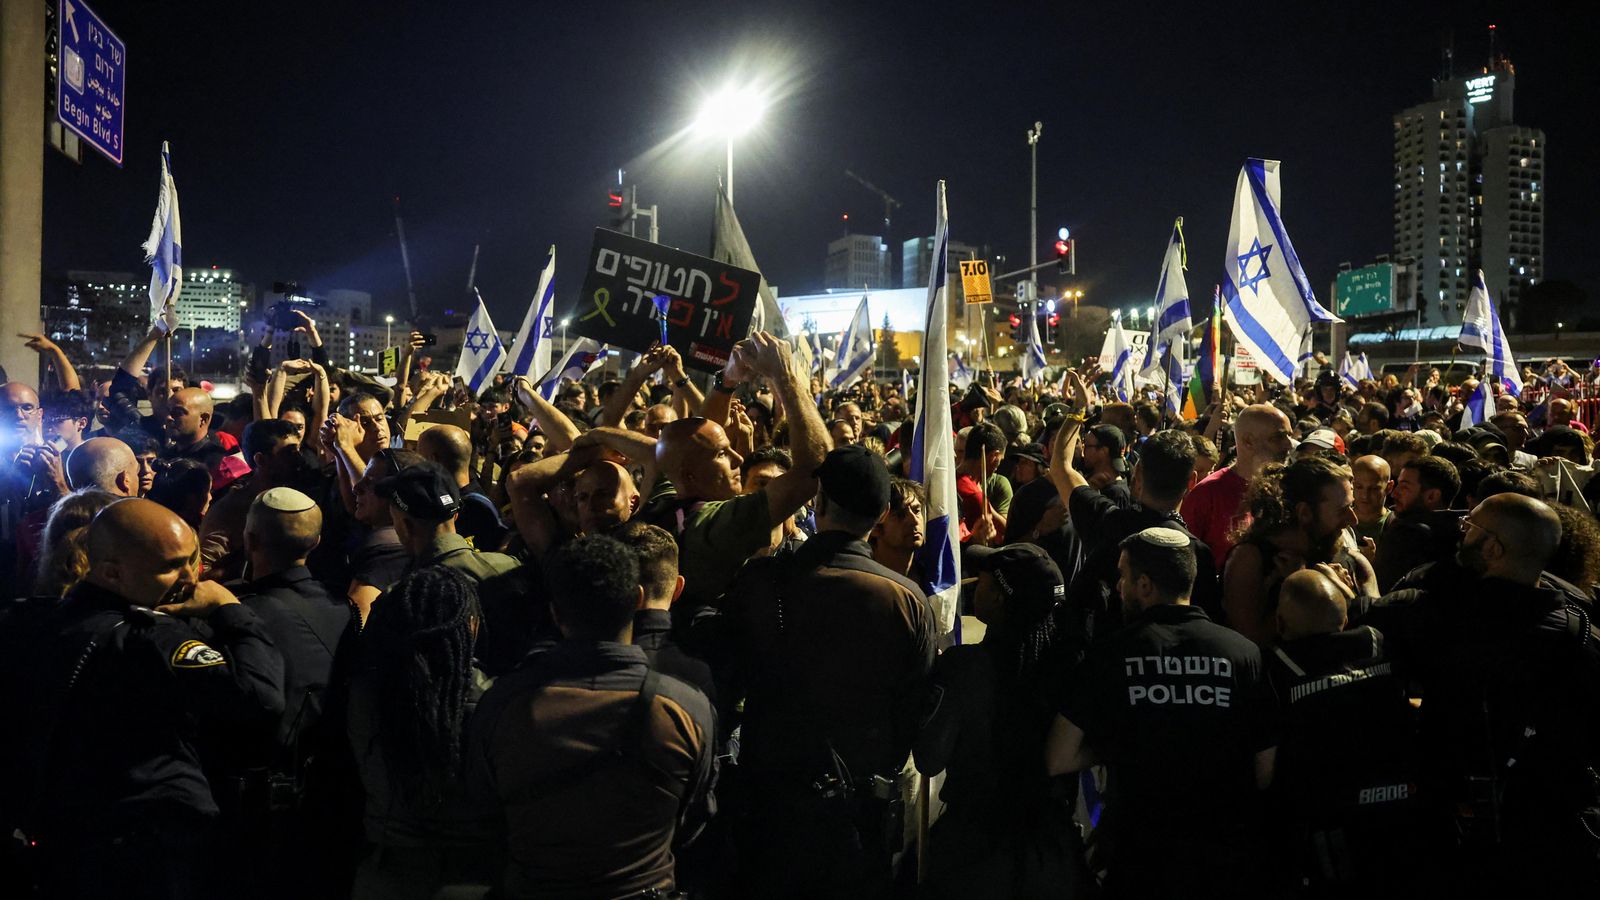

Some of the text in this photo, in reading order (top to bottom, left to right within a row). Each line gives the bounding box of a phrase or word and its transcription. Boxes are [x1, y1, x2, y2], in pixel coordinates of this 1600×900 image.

[88, 21, 104, 49] בגין
[95, 53, 114, 83] דרום
[1465, 75, 1496, 90] VERT
[64, 94, 119, 150] Begin Blvd S
[961, 262, 987, 276] 7.10
[700, 307, 734, 339] אין
[1125, 656, 1232, 678] משטרה
[1128, 684, 1231, 708] POLICE
